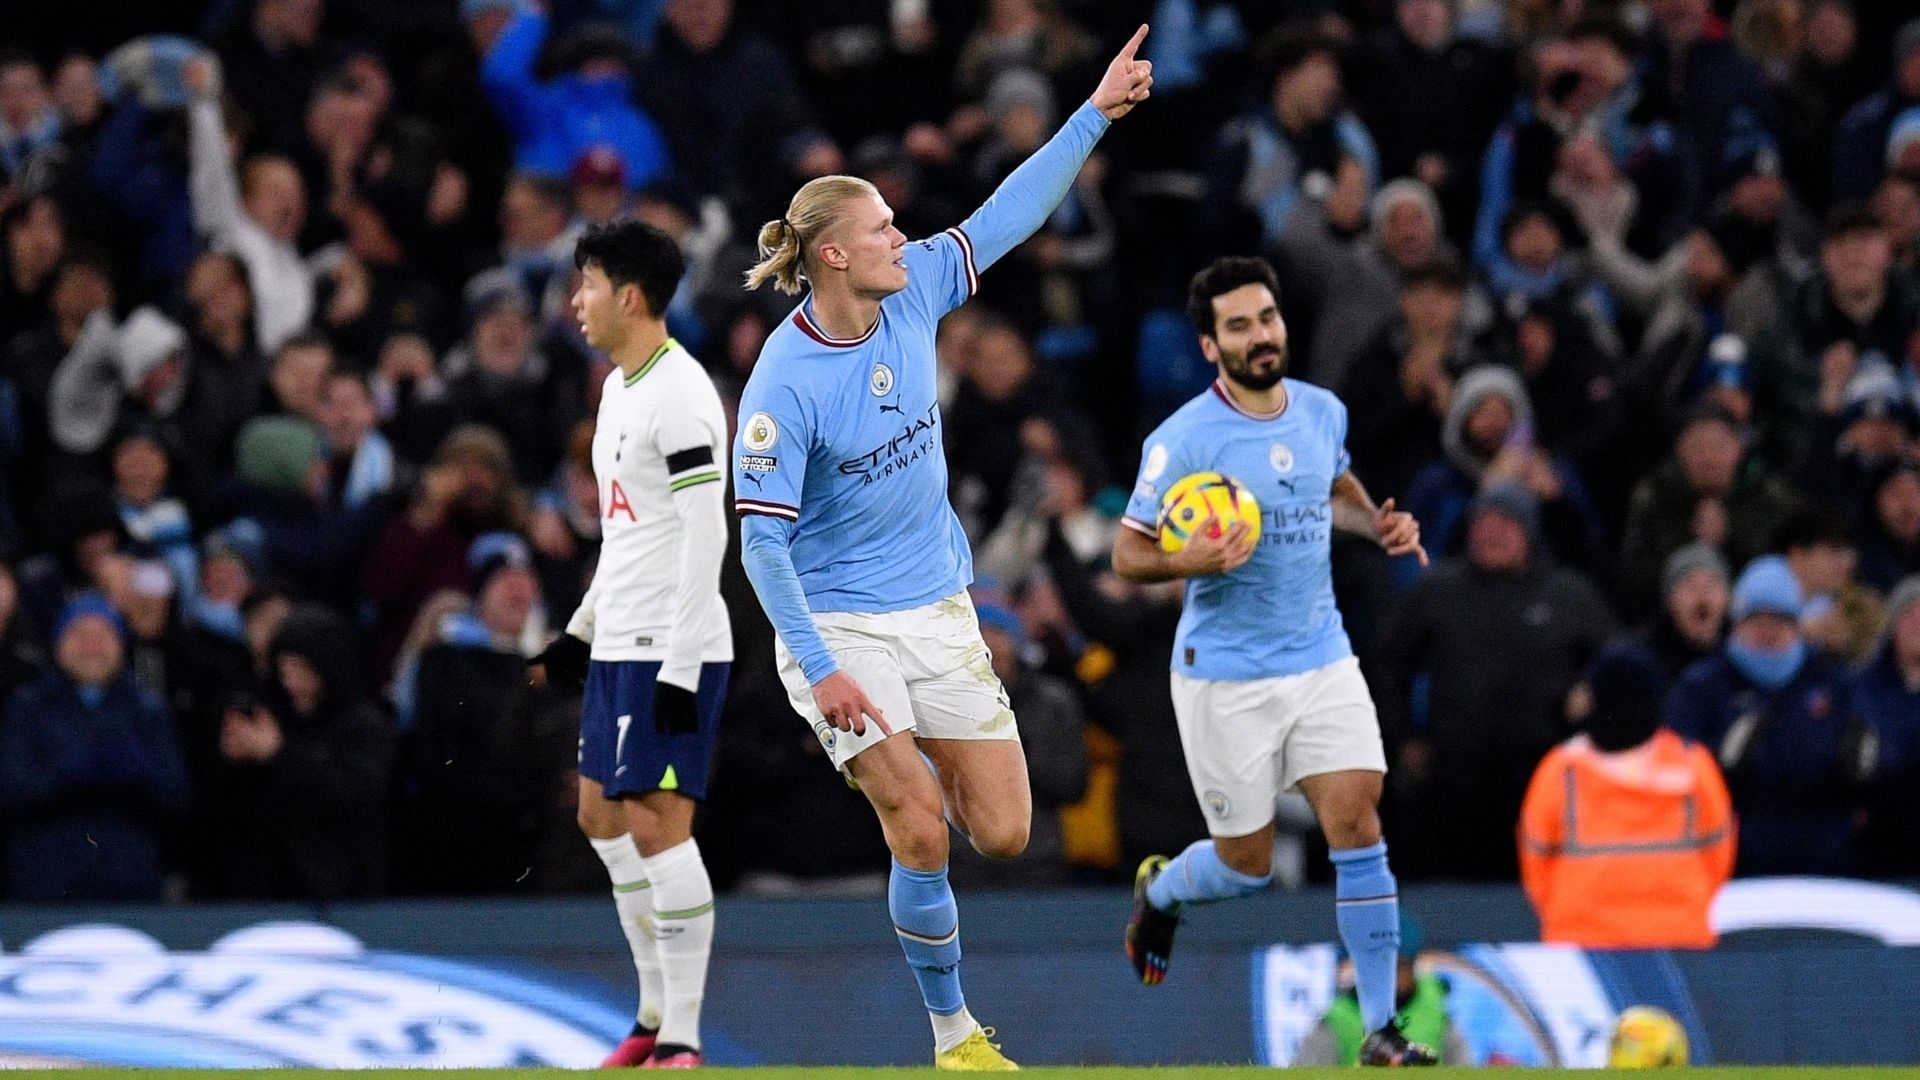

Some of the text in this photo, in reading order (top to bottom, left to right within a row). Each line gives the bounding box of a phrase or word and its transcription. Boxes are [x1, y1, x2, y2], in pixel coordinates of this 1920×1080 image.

[740, 455, 774, 466] No room
[863, 436, 934, 487] AIRWAYS
